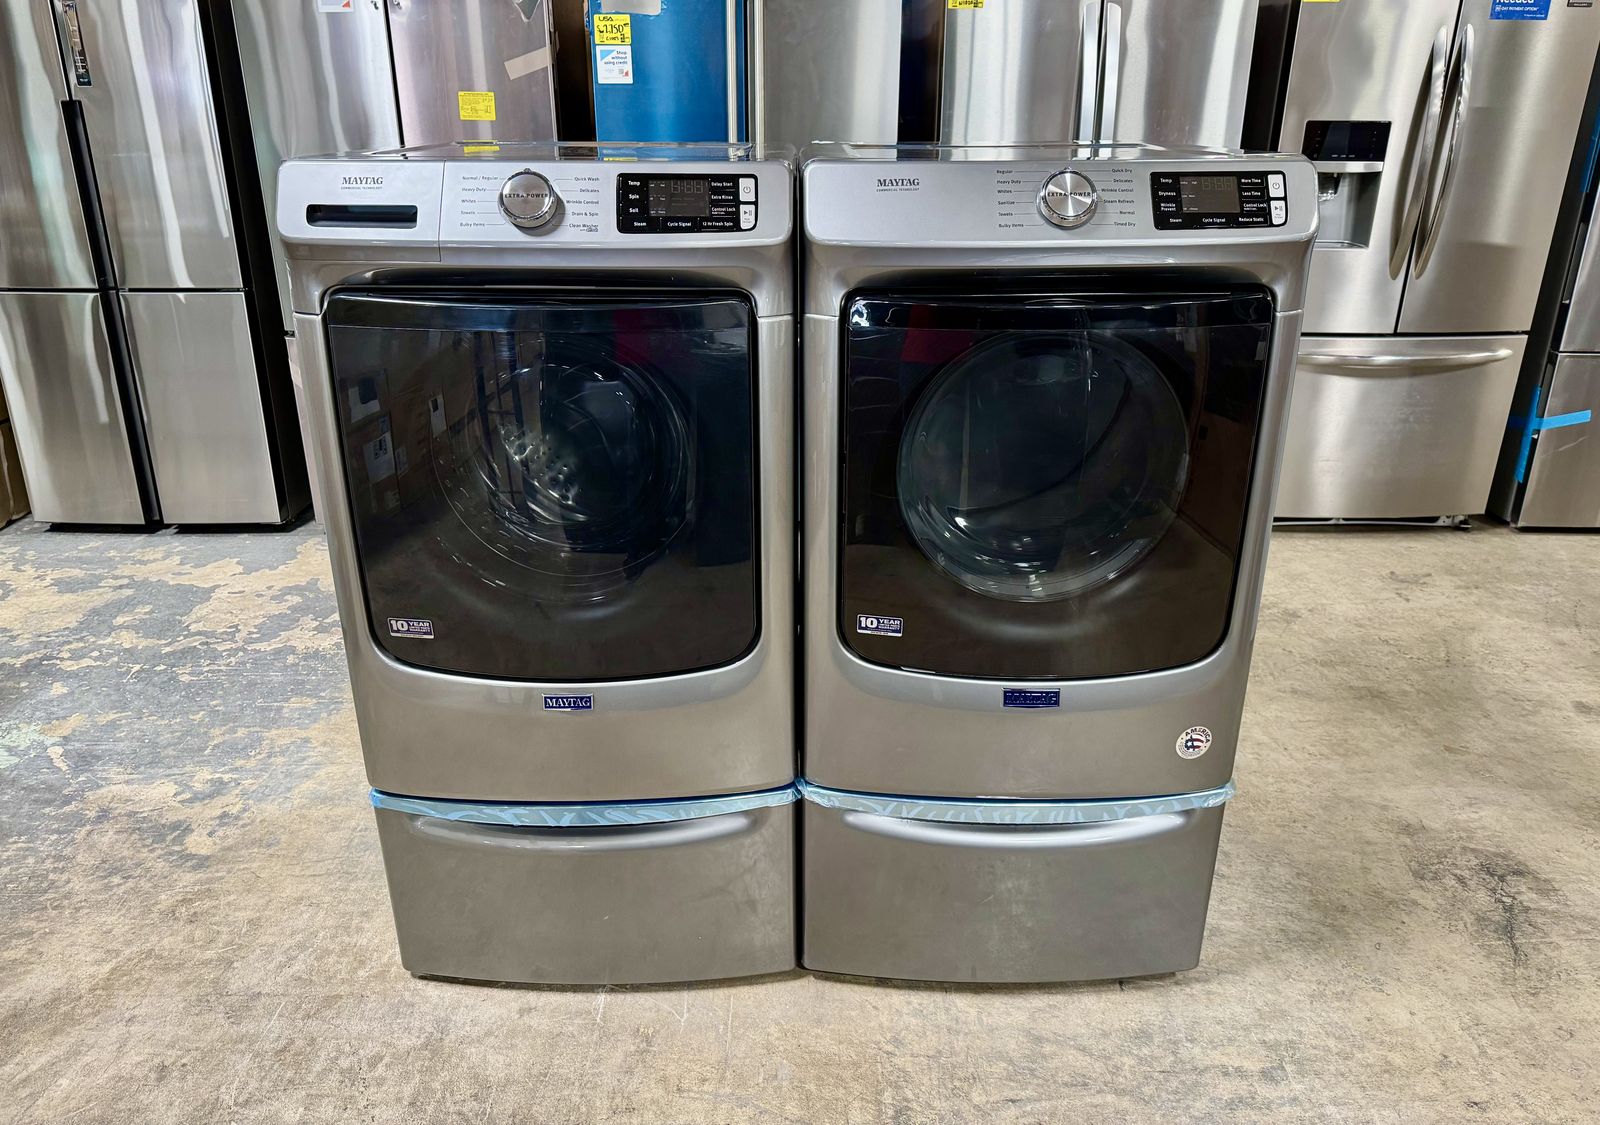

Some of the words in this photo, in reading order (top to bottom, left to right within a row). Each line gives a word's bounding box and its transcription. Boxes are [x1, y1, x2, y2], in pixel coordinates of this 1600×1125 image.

[342, 176, 384, 185] MAYTAG
[877, 178, 920, 188] MAYTAG
[390, 620, 408, 631] 10
[860, 616, 878, 628] 10
[545, 698, 590, 707] MAYTAG
[1185, 727, 1211, 744] AMERICA
